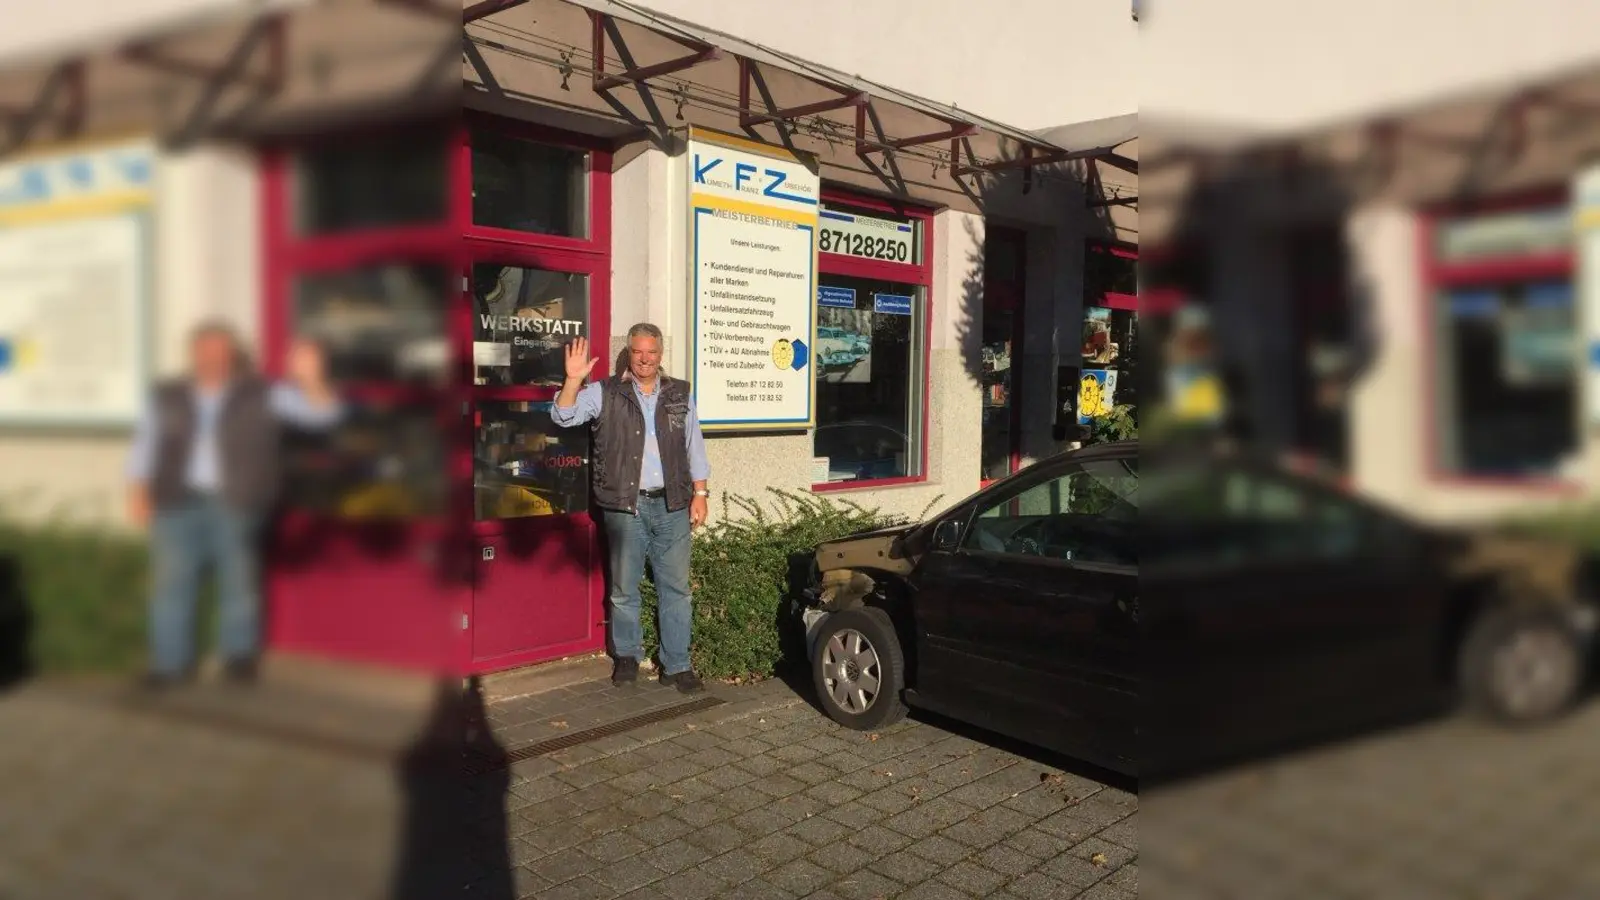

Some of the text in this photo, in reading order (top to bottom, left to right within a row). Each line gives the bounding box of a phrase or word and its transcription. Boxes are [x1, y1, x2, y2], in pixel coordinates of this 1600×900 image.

[711, 208, 798, 230] MEISTERBETRIEB
[730, 238, 750, 247] Unsere
[819, 228, 907, 262] 87128250
[710, 262, 805, 280] Kundendienst und Reparaturen
[710, 276, 749, 287] aller Marken
[710, 290, 776, 305] Unfallinstandsetzung
[710, 304, 774, 318] Unfallersatzfahrzeug
[480, 313, 583, 335] WERKSTATT
[710, 318, 791, 332] Neu- und Gebrauchtwagen
[709, 332, 764, 344] TÜV-Vorbereitung
[709, 346, 723, 354] TÜV
[730, 347, 740, 355] AU
[741, 348, 770, 356] Abnahme
[709, 360, 765, 370] Teile und Zubehör
[726, 379, 749, 388] Telefon
[726, 393, 748, 401] Telefax
